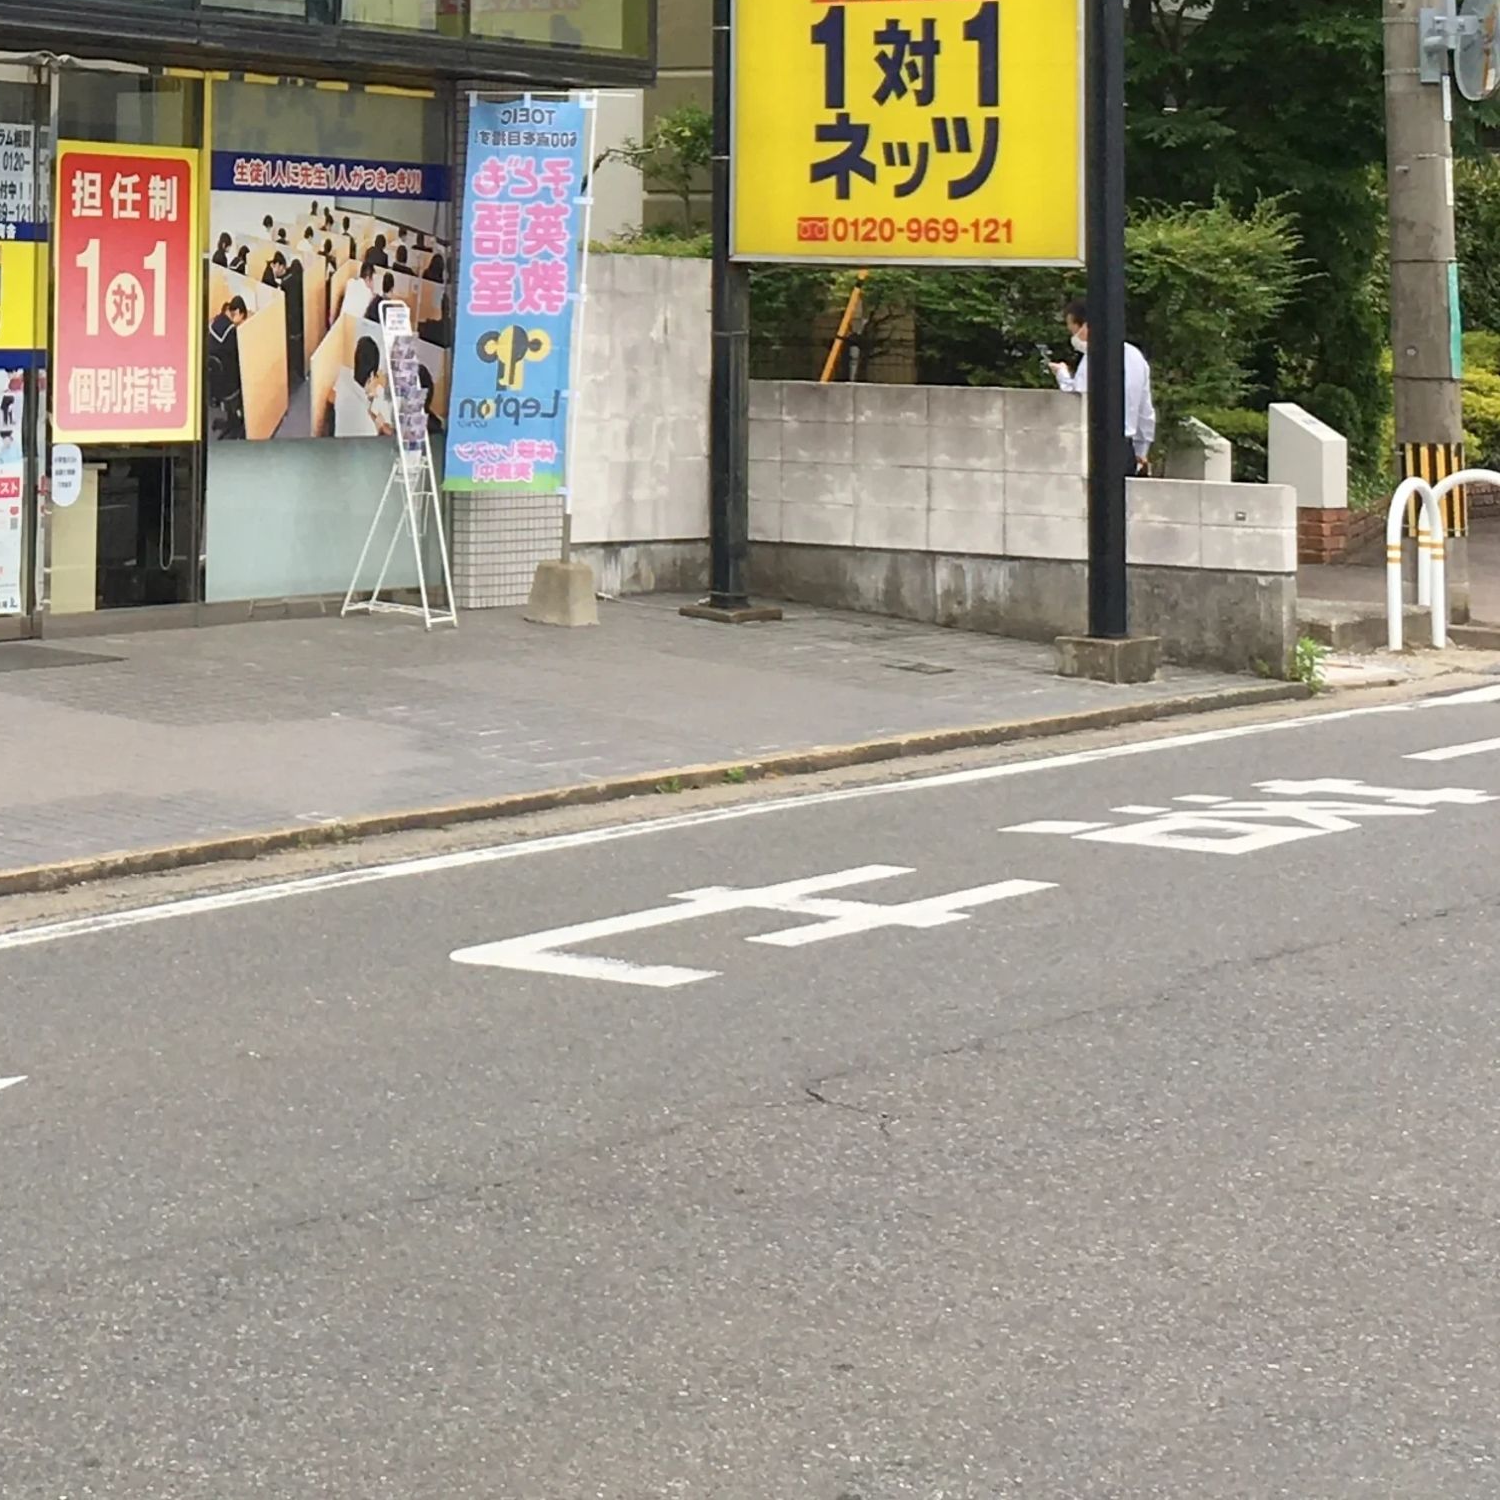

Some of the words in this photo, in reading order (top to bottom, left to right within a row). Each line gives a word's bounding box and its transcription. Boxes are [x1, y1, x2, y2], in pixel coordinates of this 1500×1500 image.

[811, 1, 1000, 109] 1対1
[809, 112, 1000, 201] ネッツ
[71, 171, 179, 222] 担任制
[832, 217, 1014, 244] 0120-969-121
[75, 238, 167, 338] 1対1
[68, 366, 177, 415] 個別指導
